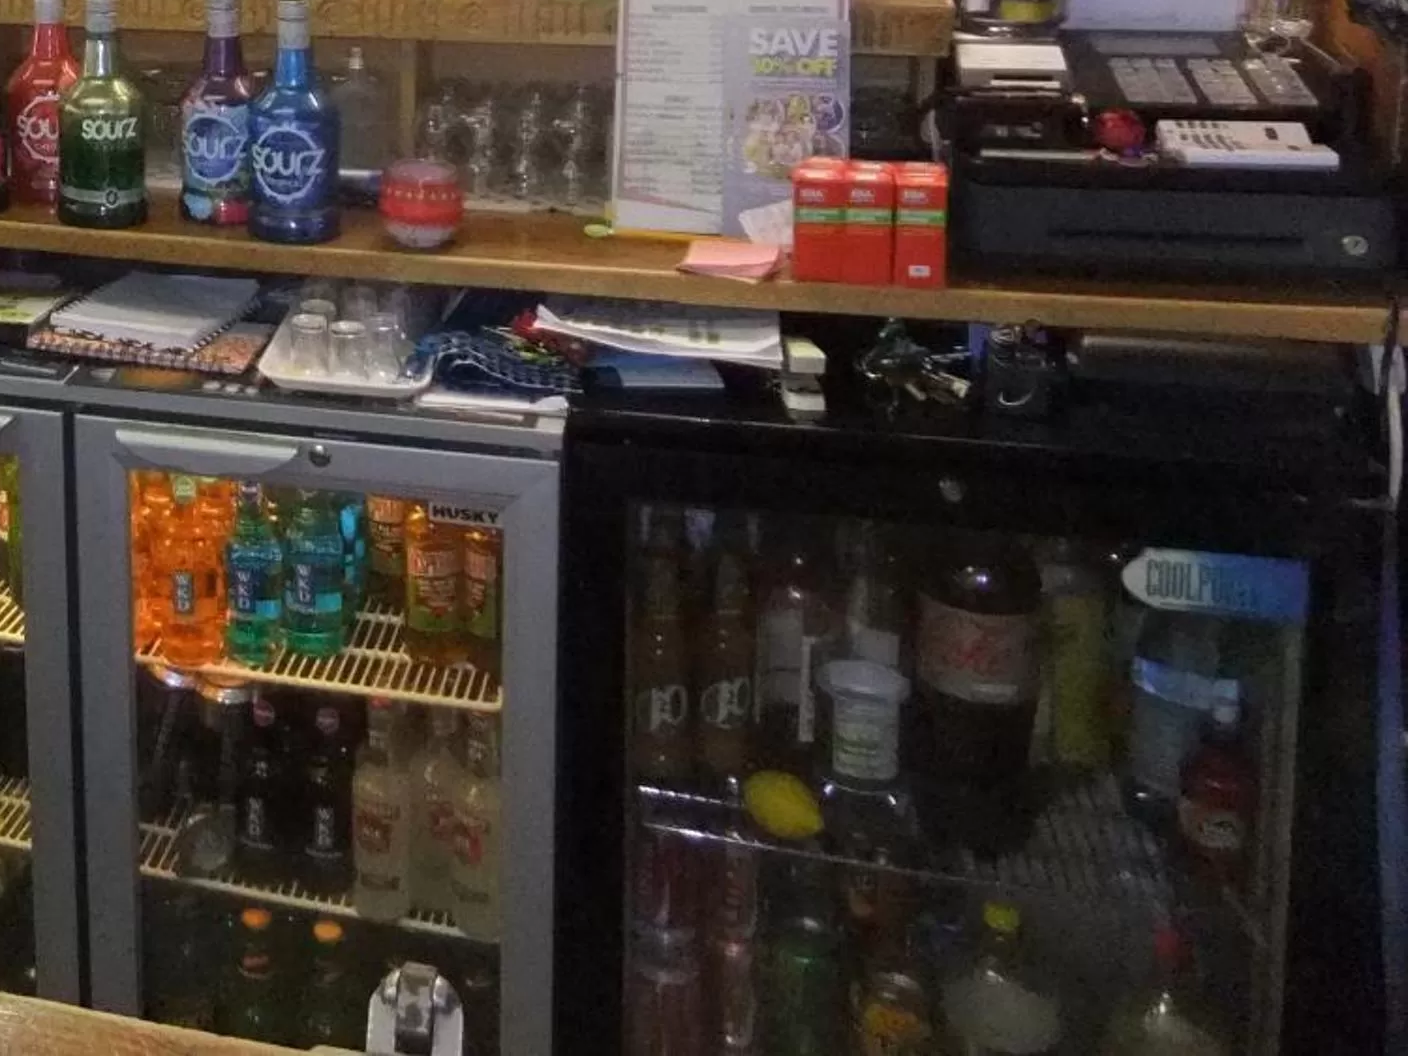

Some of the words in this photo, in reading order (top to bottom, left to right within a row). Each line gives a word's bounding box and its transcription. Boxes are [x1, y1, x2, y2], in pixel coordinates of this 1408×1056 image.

[748, 27, 839, 57] SAVE
[796, 56, 838, 77] OFF
[16, 115, 60, 141] sou
[430, 504, 500, 523] HUSKY
